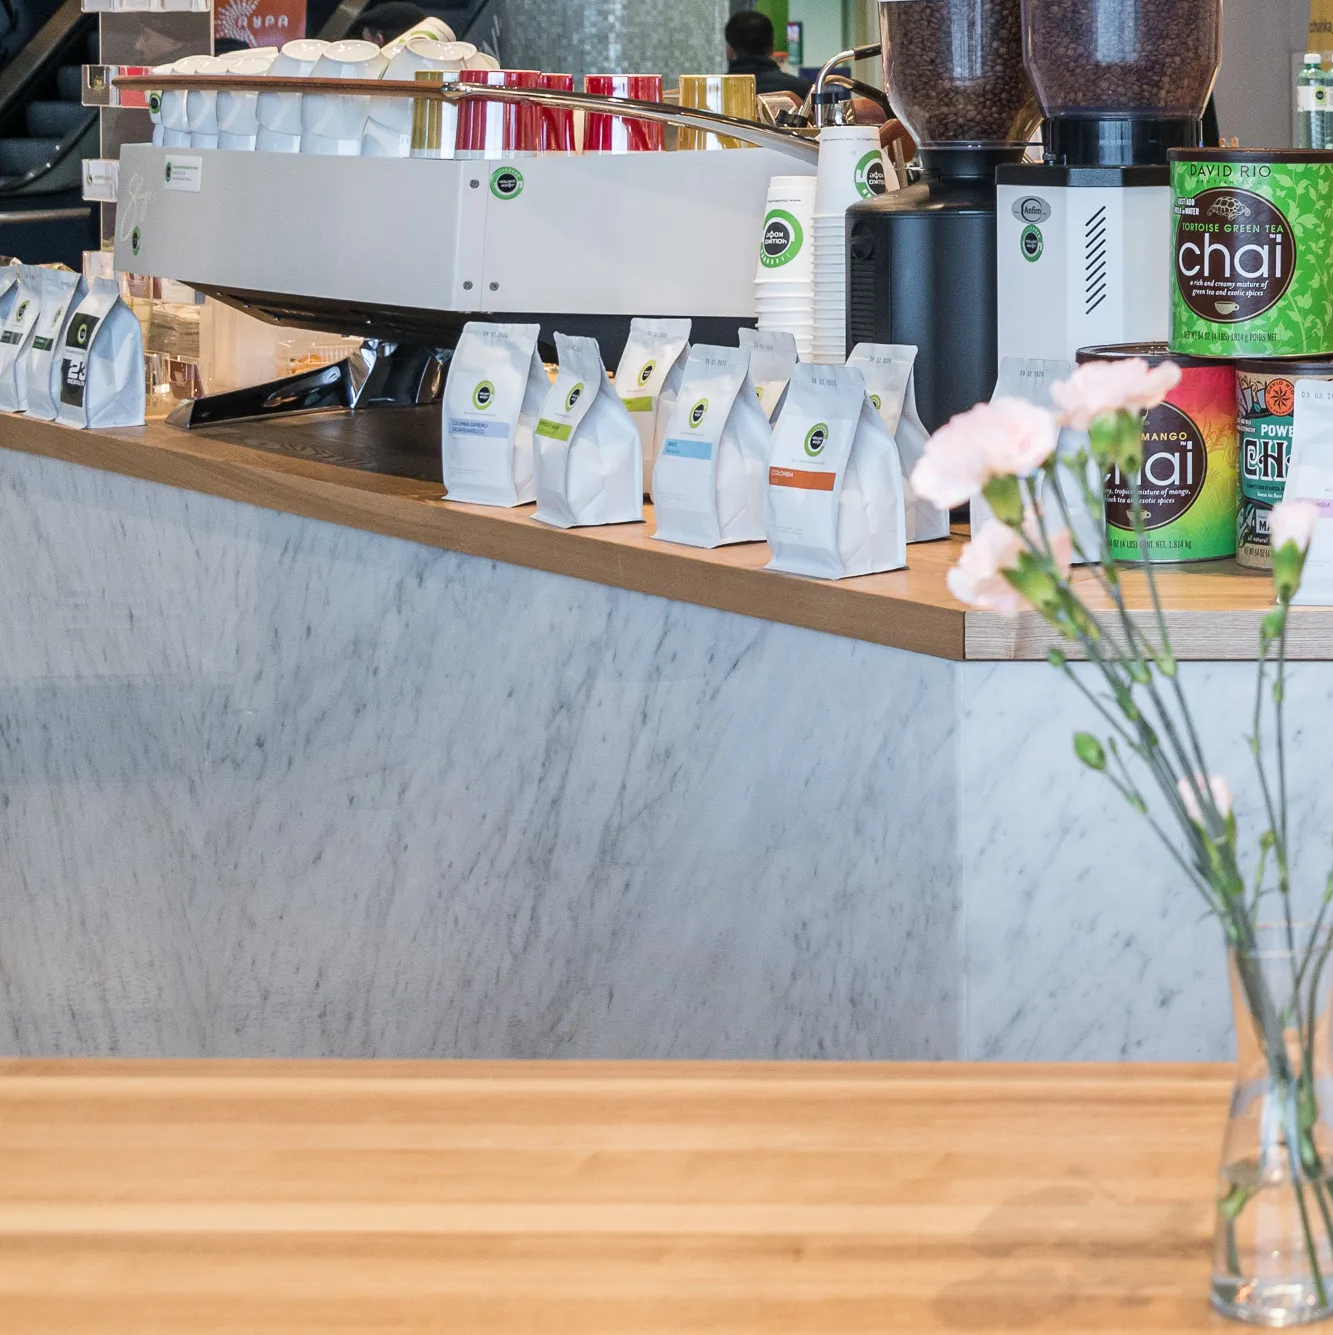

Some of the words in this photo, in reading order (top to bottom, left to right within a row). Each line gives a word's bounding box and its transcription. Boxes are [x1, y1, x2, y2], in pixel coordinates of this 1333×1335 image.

[1190, 165, 1232, 177] DAVID
[1240, 165, 1271, 178] RIO
[1024, 205, 1042, 215] Anfim
[1182, 223, 1220, 233] TORTOISE
[1223, 224, 1260, 233] GREEN
[1265, 225, 1284, 233] TEA
[1178, 233, 1282, 279] chai
[1215, 281, 1235, 289] creamy
[1261, 280, 1269, 289] of
[1218, 332, 1230, 342] LBS)
[1249, 332, 1266, 341] POIDS
[1267, 332, 1277, 341] NET
[1261, 424, 1294, 437] POWE
[1141, 432, 1187, 441] MANGO
[1161, 487, 1168, 496] of
[1169, 489, 1191, 497] mango,
[1112, 541, 1119, 549] OZ
[1126, 540, 1137, 550] LBS)
[1169, 539, 1184, 549] 1.814
